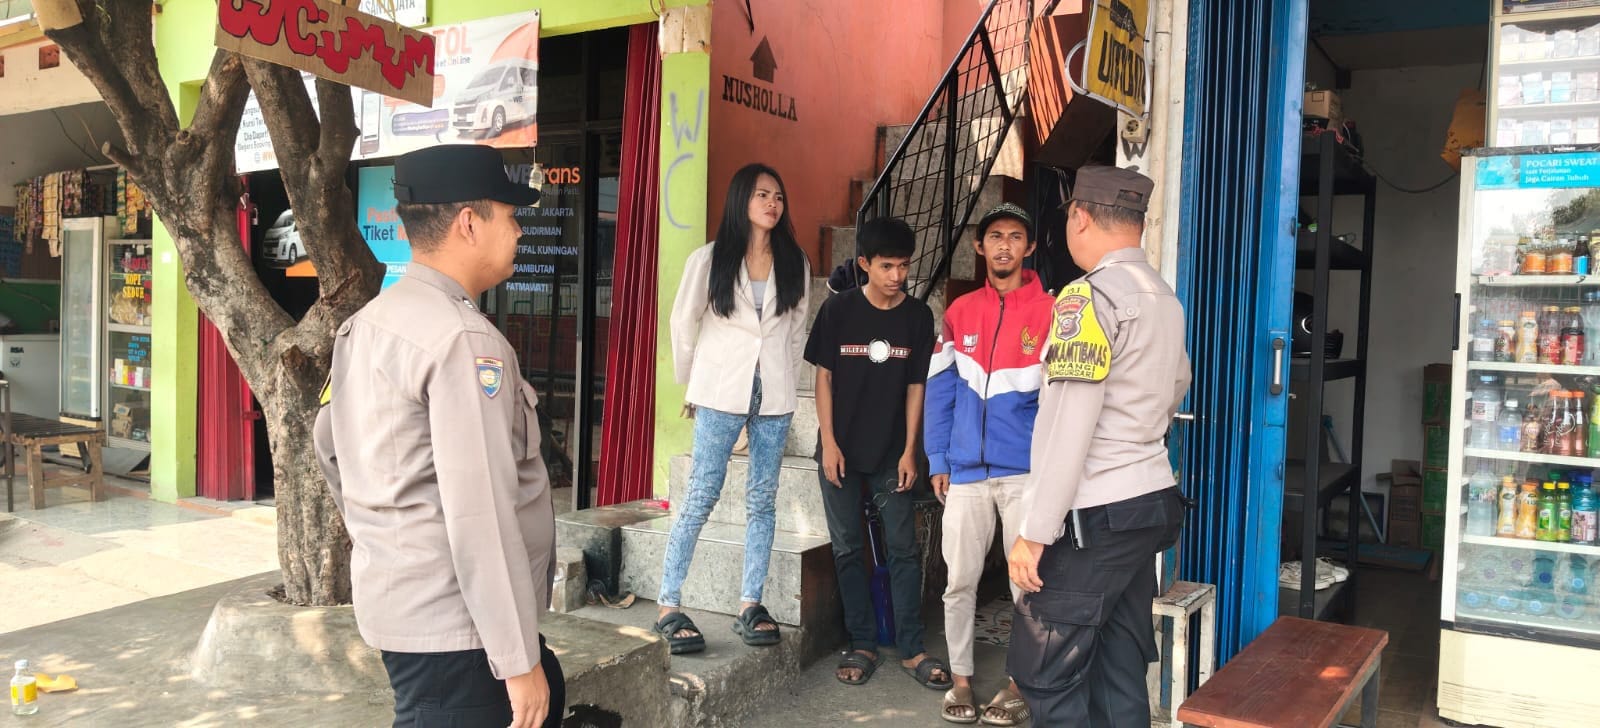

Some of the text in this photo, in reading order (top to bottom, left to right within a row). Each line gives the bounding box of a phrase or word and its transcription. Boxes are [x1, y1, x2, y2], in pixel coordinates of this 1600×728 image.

[722, 75, 798, 121] MUSHOLLA
[1526, 157, 1597, 168] POCARI SWEAT
[541, 207, 574, 217] JAKARTA
[363, 225, 394, 240] Tiket
[521, 226, 562, 236] SUDIRMAN
[538, 245, 578, 256] KUNINGAN
[514, 263, 555, 274] RAMBUTAN
[506, 282, 548, 293] FATMAWATI
